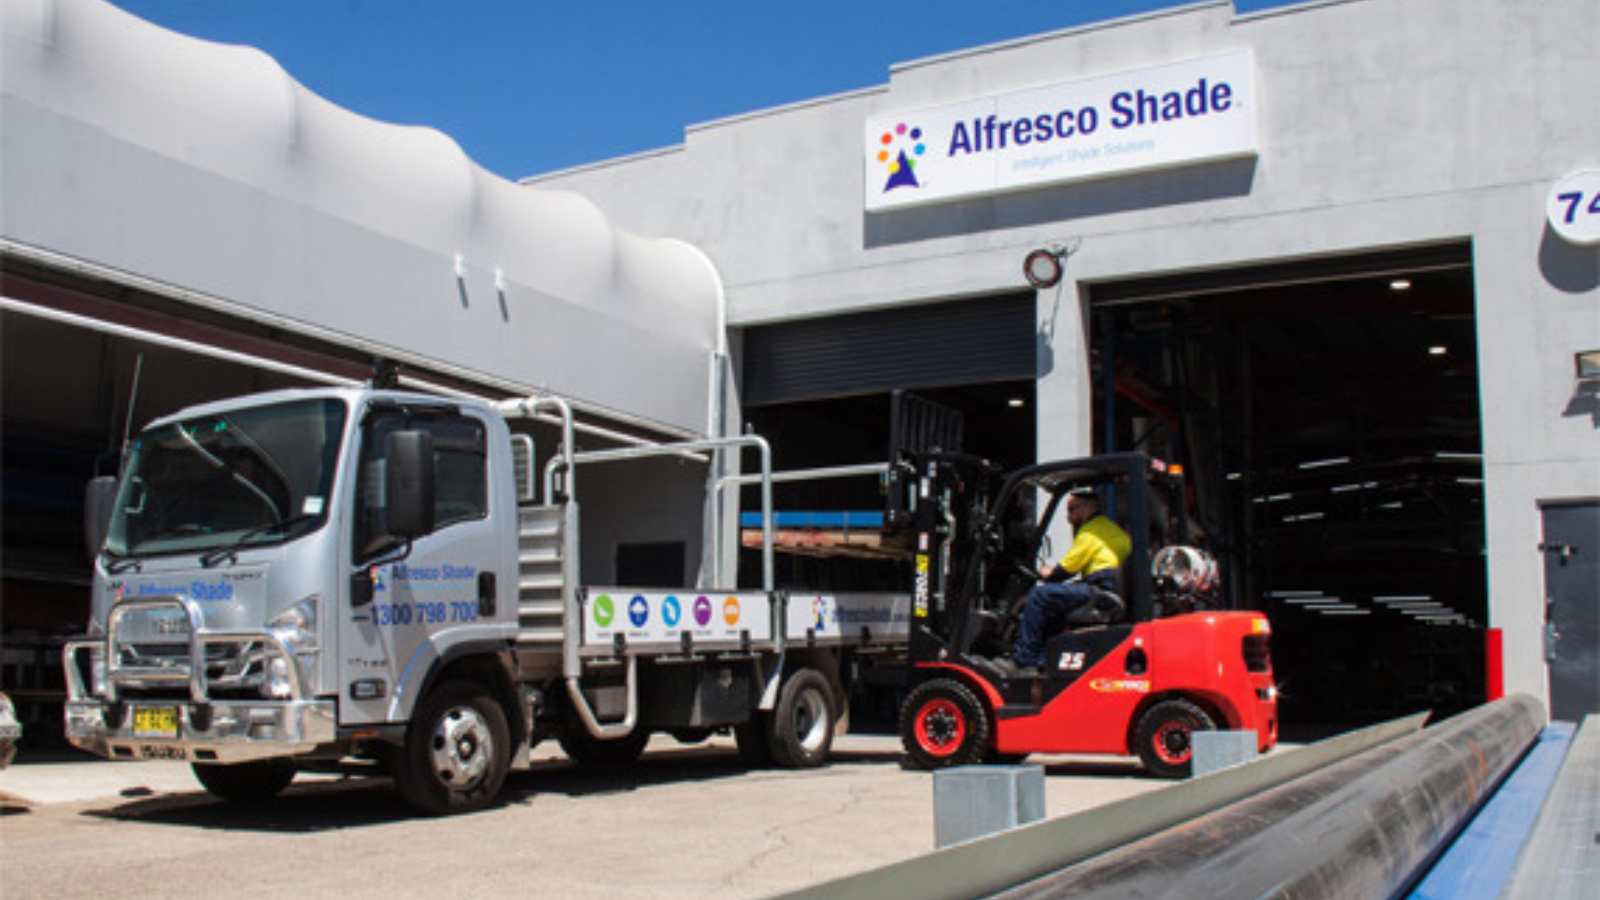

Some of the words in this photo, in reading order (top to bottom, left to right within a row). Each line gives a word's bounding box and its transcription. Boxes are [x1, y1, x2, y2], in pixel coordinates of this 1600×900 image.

[948, 105, 1098, 158] Alfresco
[1110, 78, 1234, 129] Shade
[191, 578, 233, 601] Shade
[370, 603, 412, 626] 1300
[415, 601, 447, 623] 798
[450, 601, 478, 622] 700
